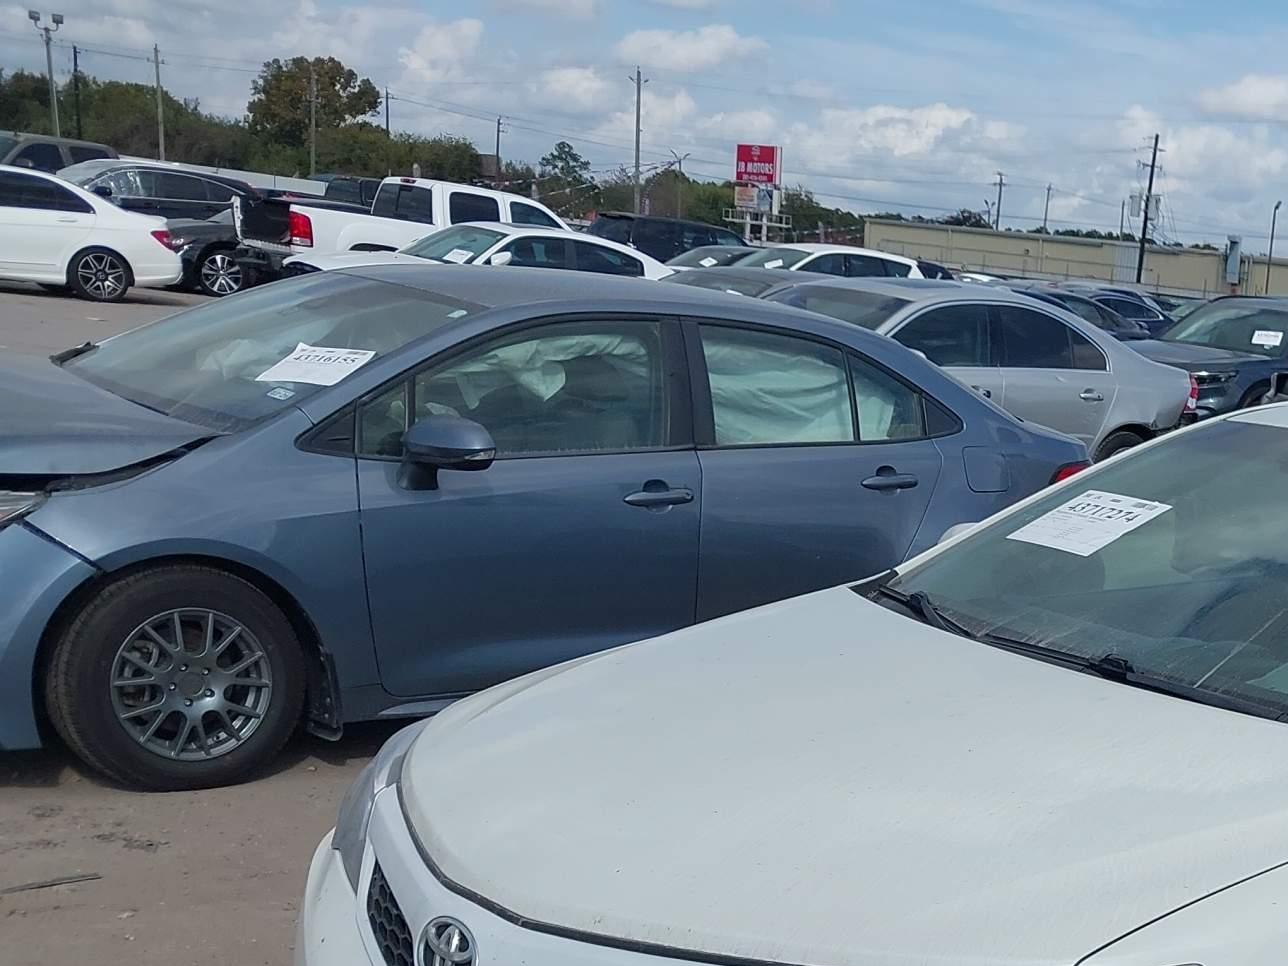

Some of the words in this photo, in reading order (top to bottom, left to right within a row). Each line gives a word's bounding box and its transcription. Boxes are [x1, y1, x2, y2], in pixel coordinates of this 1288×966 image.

[737, 160, 745, 172] JB
[746, 161, 773, 175] MOTORS
[1067, 502, 1142, 523] 43717274
